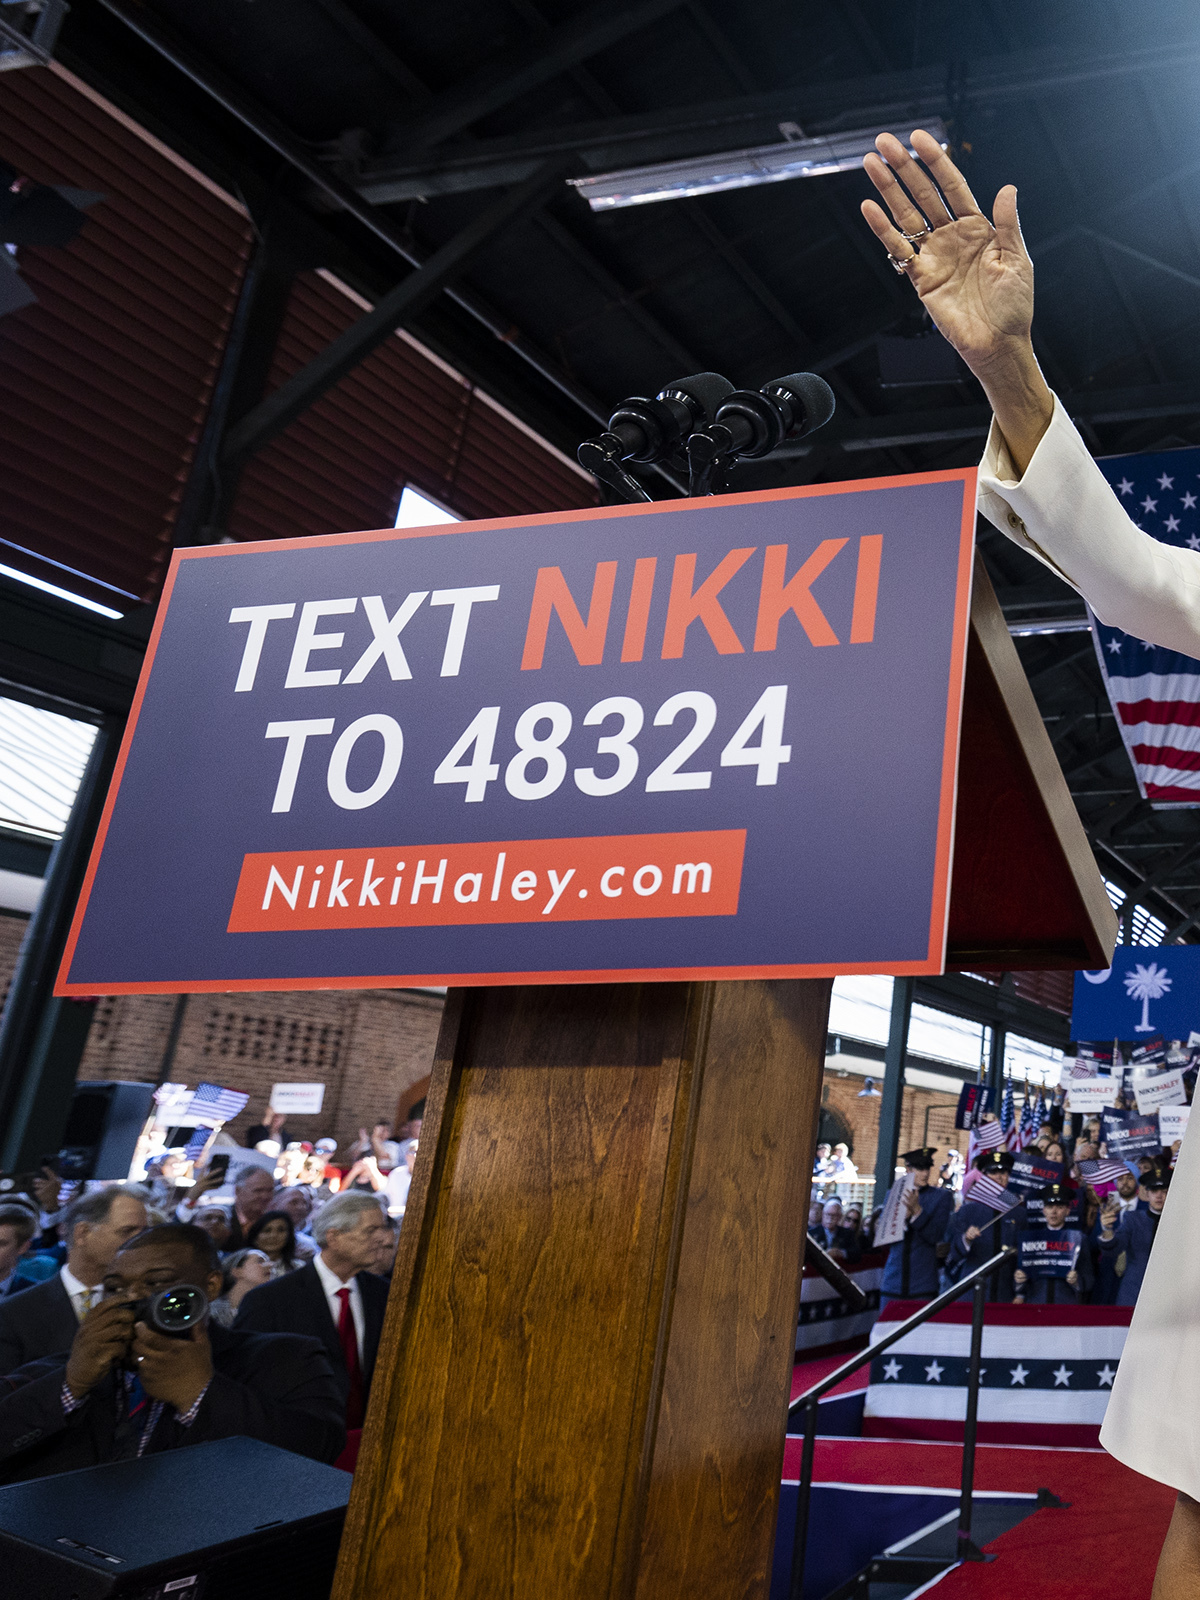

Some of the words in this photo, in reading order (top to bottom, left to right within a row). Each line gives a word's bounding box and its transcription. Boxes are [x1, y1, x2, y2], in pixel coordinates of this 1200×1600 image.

[229, 585, 500, 692] TEXT
[521, 535, 882, 670] NIKKI
[265, 714, 403, 812] TO
[434, 685, 791, 802] 48324
[262, 853, 711, 915] NikkiHaley.com
[1022, 1241, 1075, 1252] NIKKIHALEY
